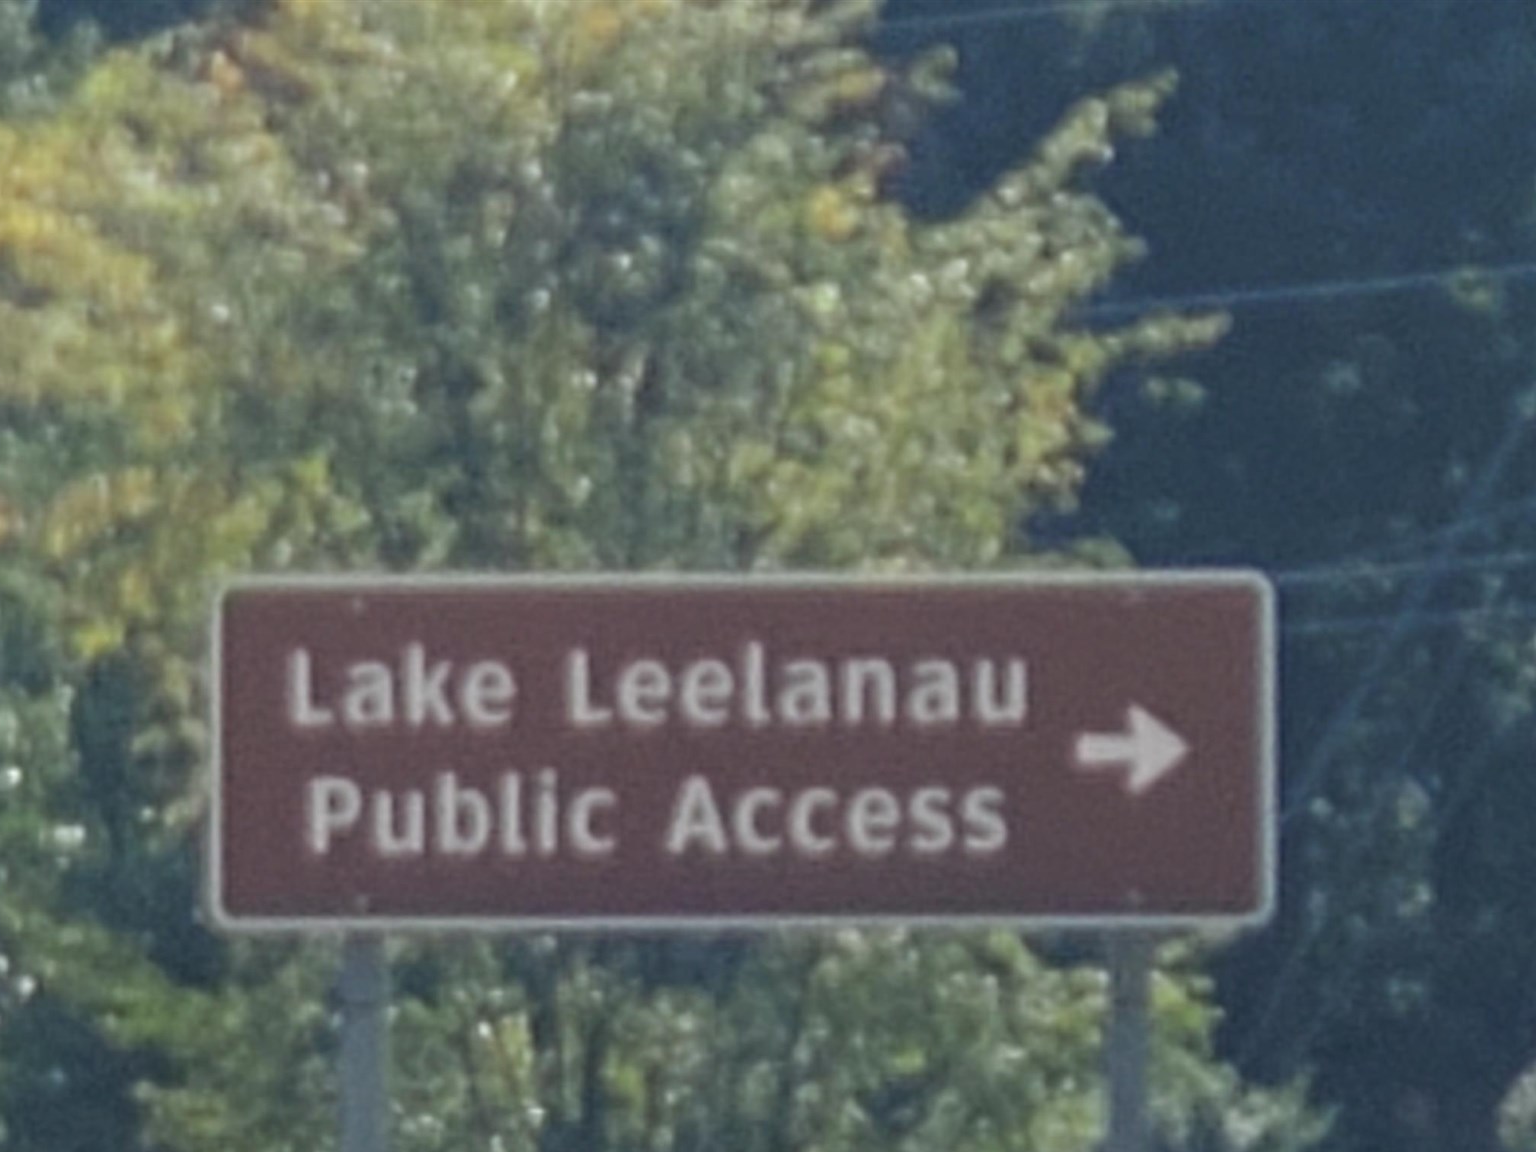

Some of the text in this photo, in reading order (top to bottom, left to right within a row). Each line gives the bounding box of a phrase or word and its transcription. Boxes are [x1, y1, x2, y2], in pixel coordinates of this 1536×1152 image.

[288, 639, 1028, 729] Lake Leelanau
[306, 768, 1008, 856] Public Access
